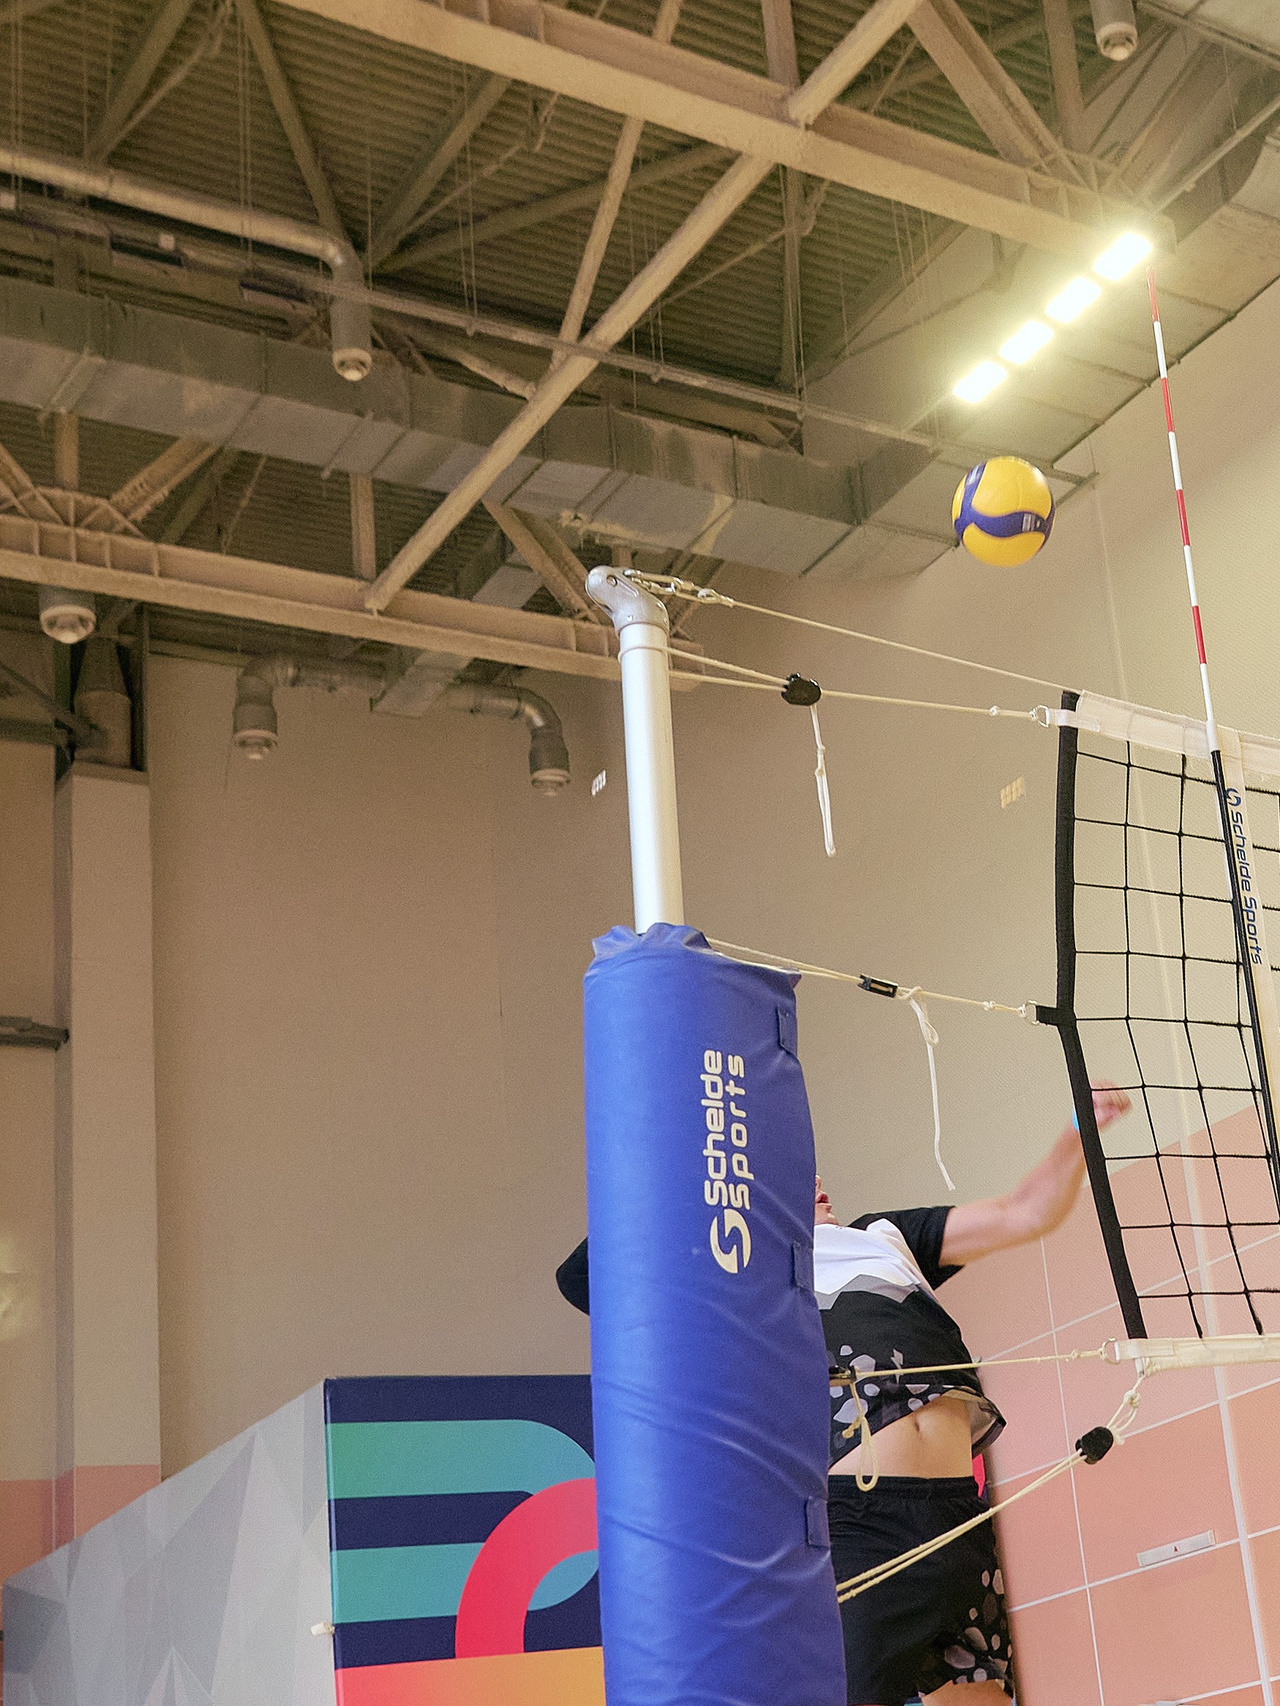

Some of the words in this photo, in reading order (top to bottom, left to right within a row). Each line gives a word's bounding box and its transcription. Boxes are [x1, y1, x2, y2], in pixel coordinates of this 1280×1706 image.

[1230, 810, 1252, 892] Schelde
[1242, 896, 1263, 965] Sports
[699, 1049, 727, 1206] Schelde
